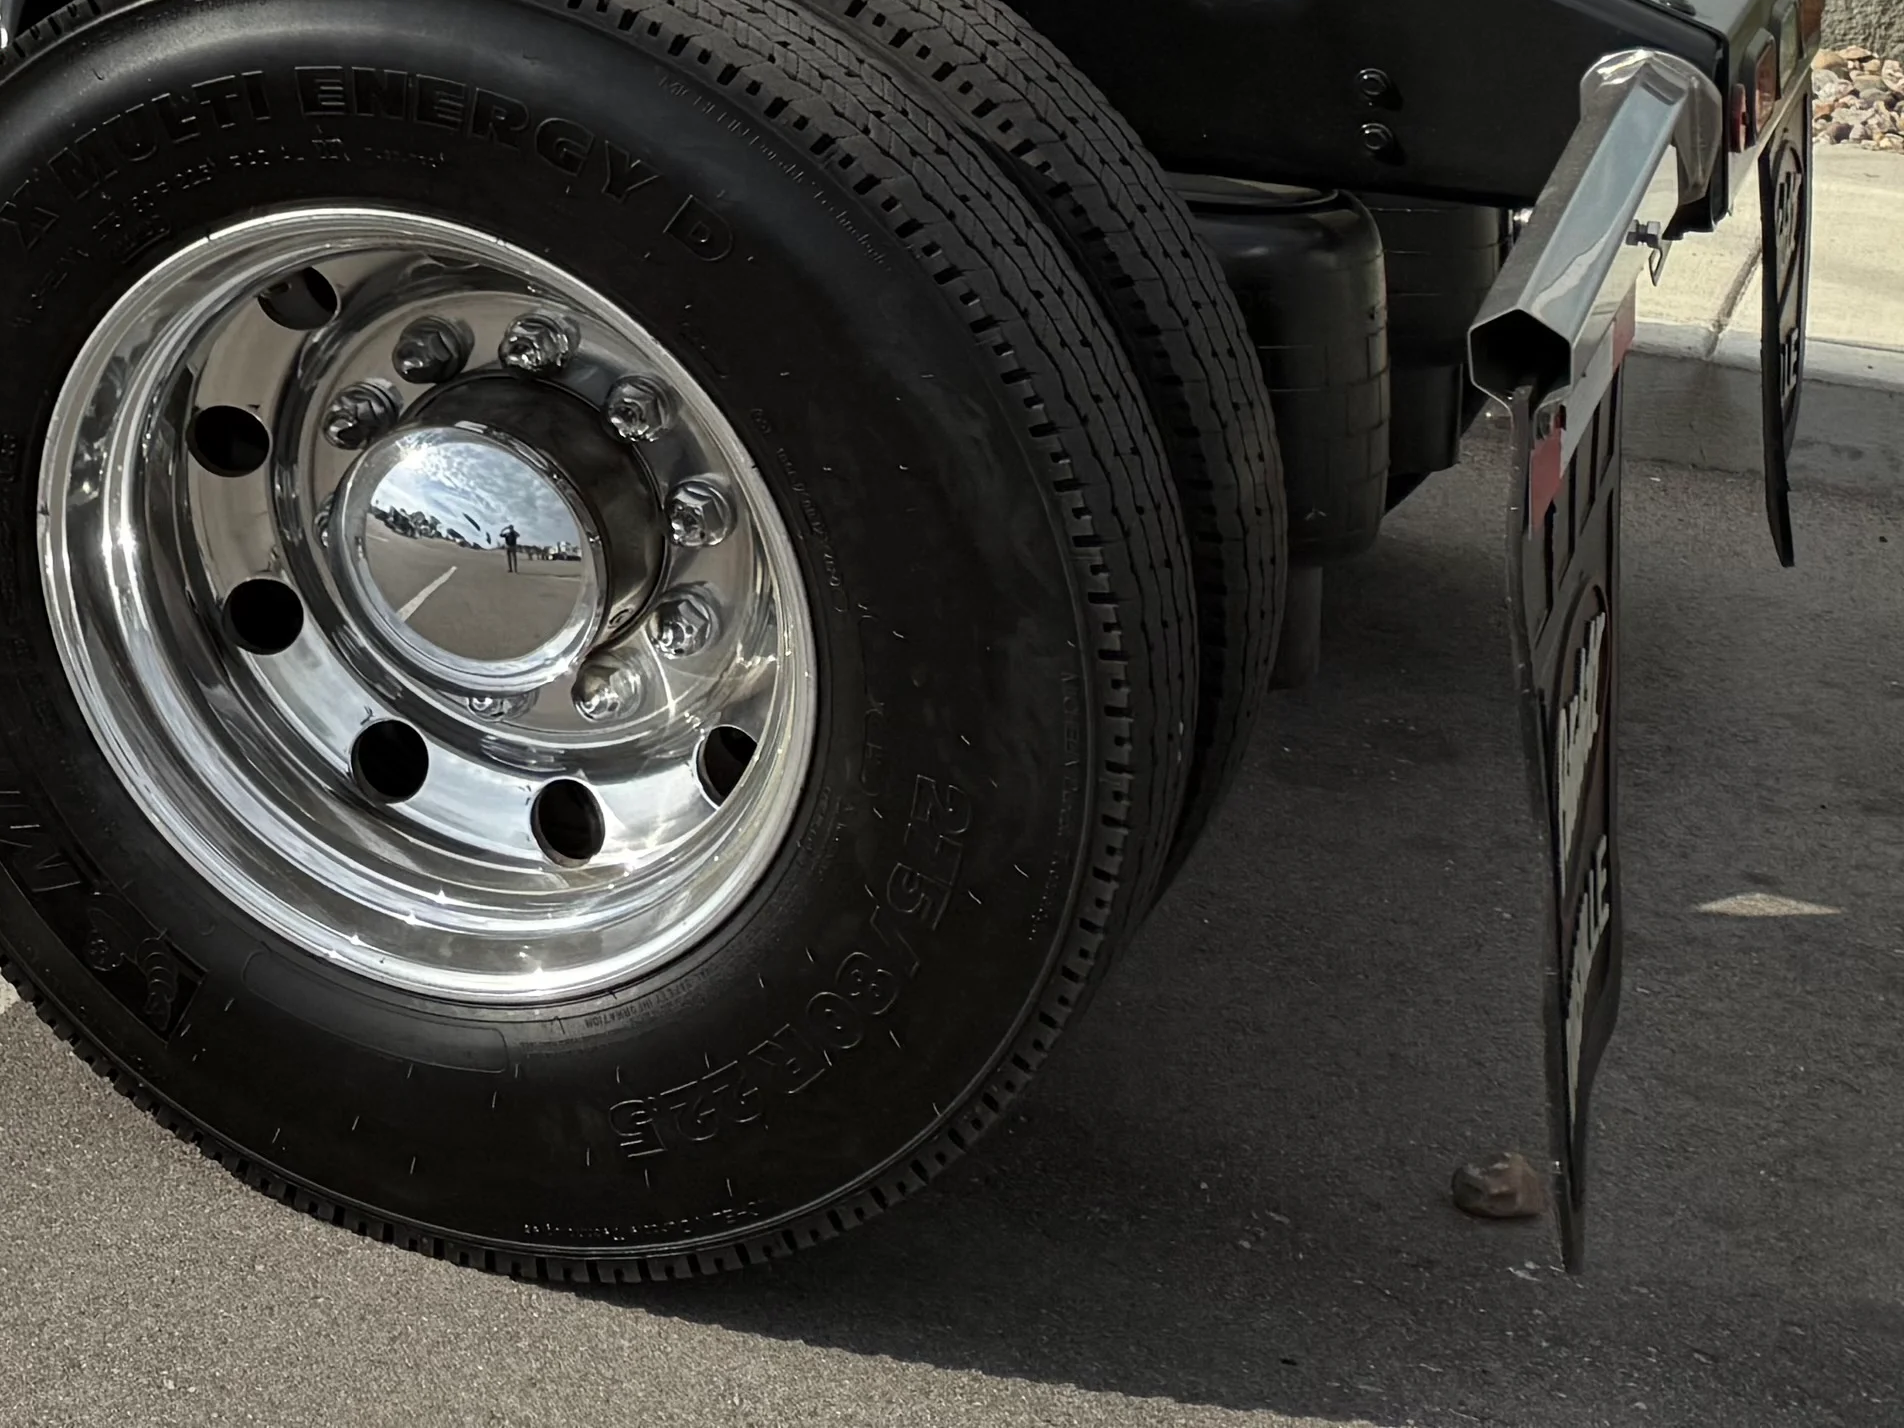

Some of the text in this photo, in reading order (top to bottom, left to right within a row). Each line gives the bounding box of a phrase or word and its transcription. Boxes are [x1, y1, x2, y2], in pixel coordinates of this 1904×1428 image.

[48, 68, 270, 204] MULTI
[294, 64, 662, 208] ENERGY
[662, 193, 735, 263] D
